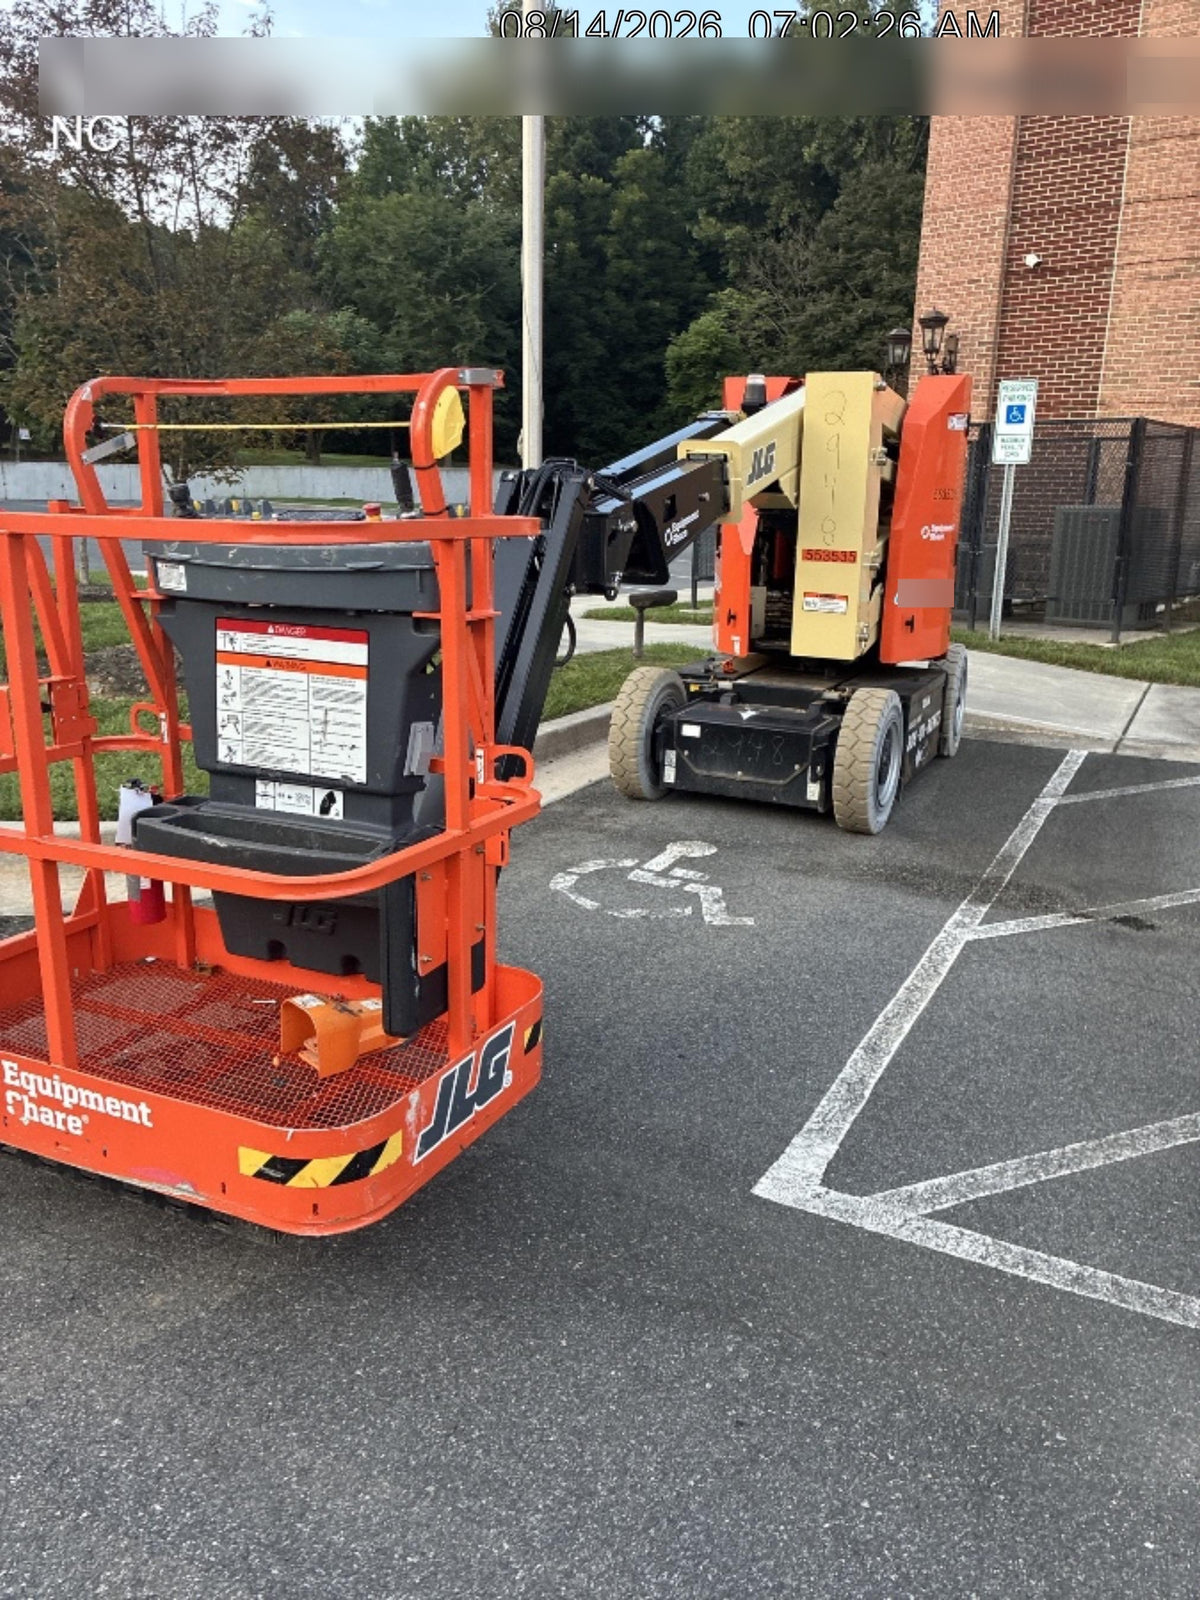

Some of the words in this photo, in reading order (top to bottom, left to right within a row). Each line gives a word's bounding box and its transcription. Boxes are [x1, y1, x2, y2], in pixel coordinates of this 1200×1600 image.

[746, 440, 776, 486] JLG
[803, 548, 857, 563] 553535
[1, 1059, 154, 1128] Equipment
[412, 1020, 516, 1167] JLG
